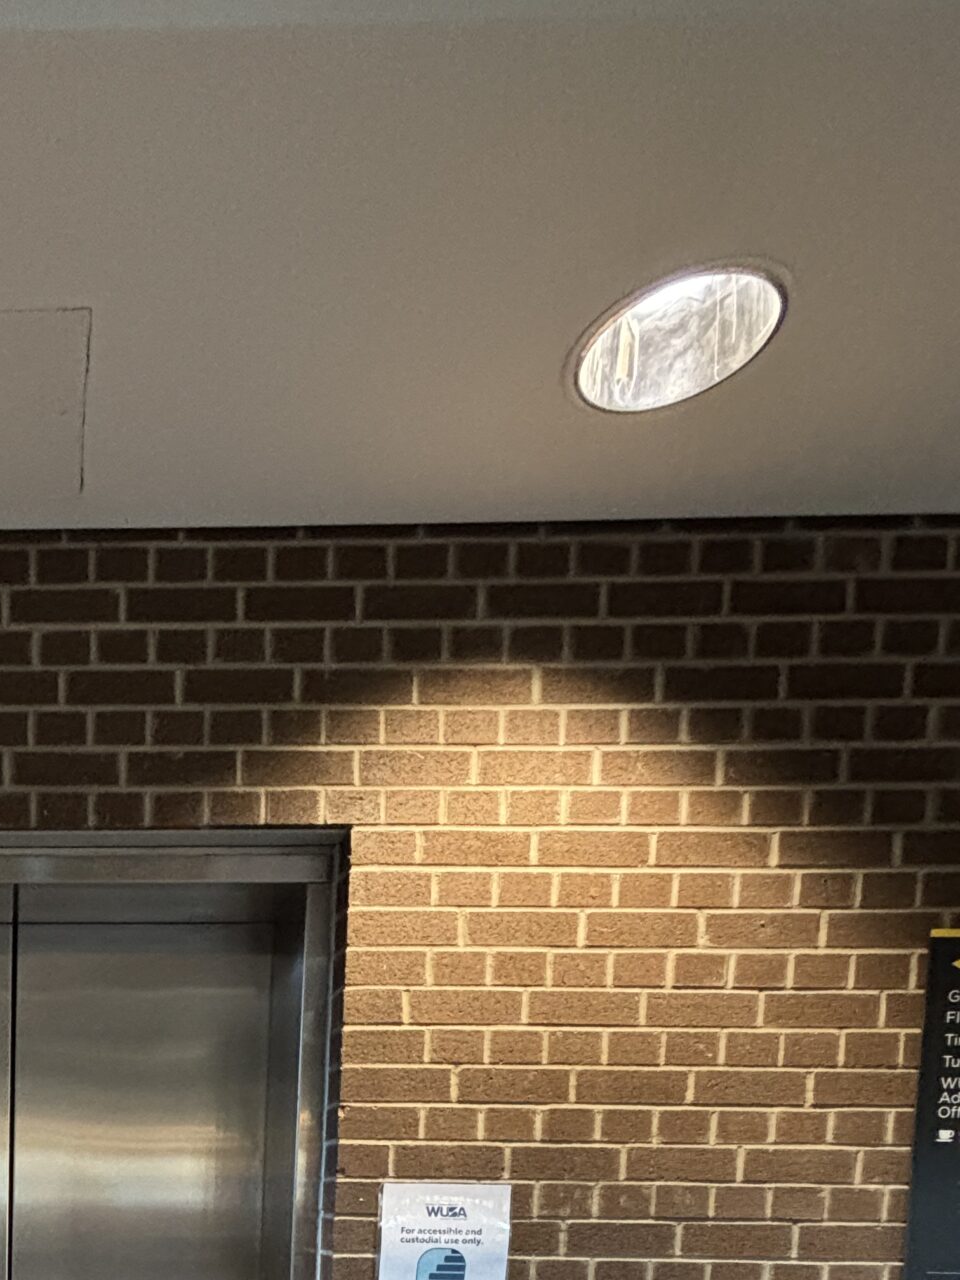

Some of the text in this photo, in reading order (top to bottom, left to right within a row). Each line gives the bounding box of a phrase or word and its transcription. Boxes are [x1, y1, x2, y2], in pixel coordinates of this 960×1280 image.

[426, 1206, 467, 1218] WUSA
[400, 1226, 482, 1236] For accessible and
[400, 1236, 441, 1244] custodial
[461, 1237, 484, 1247] only.
